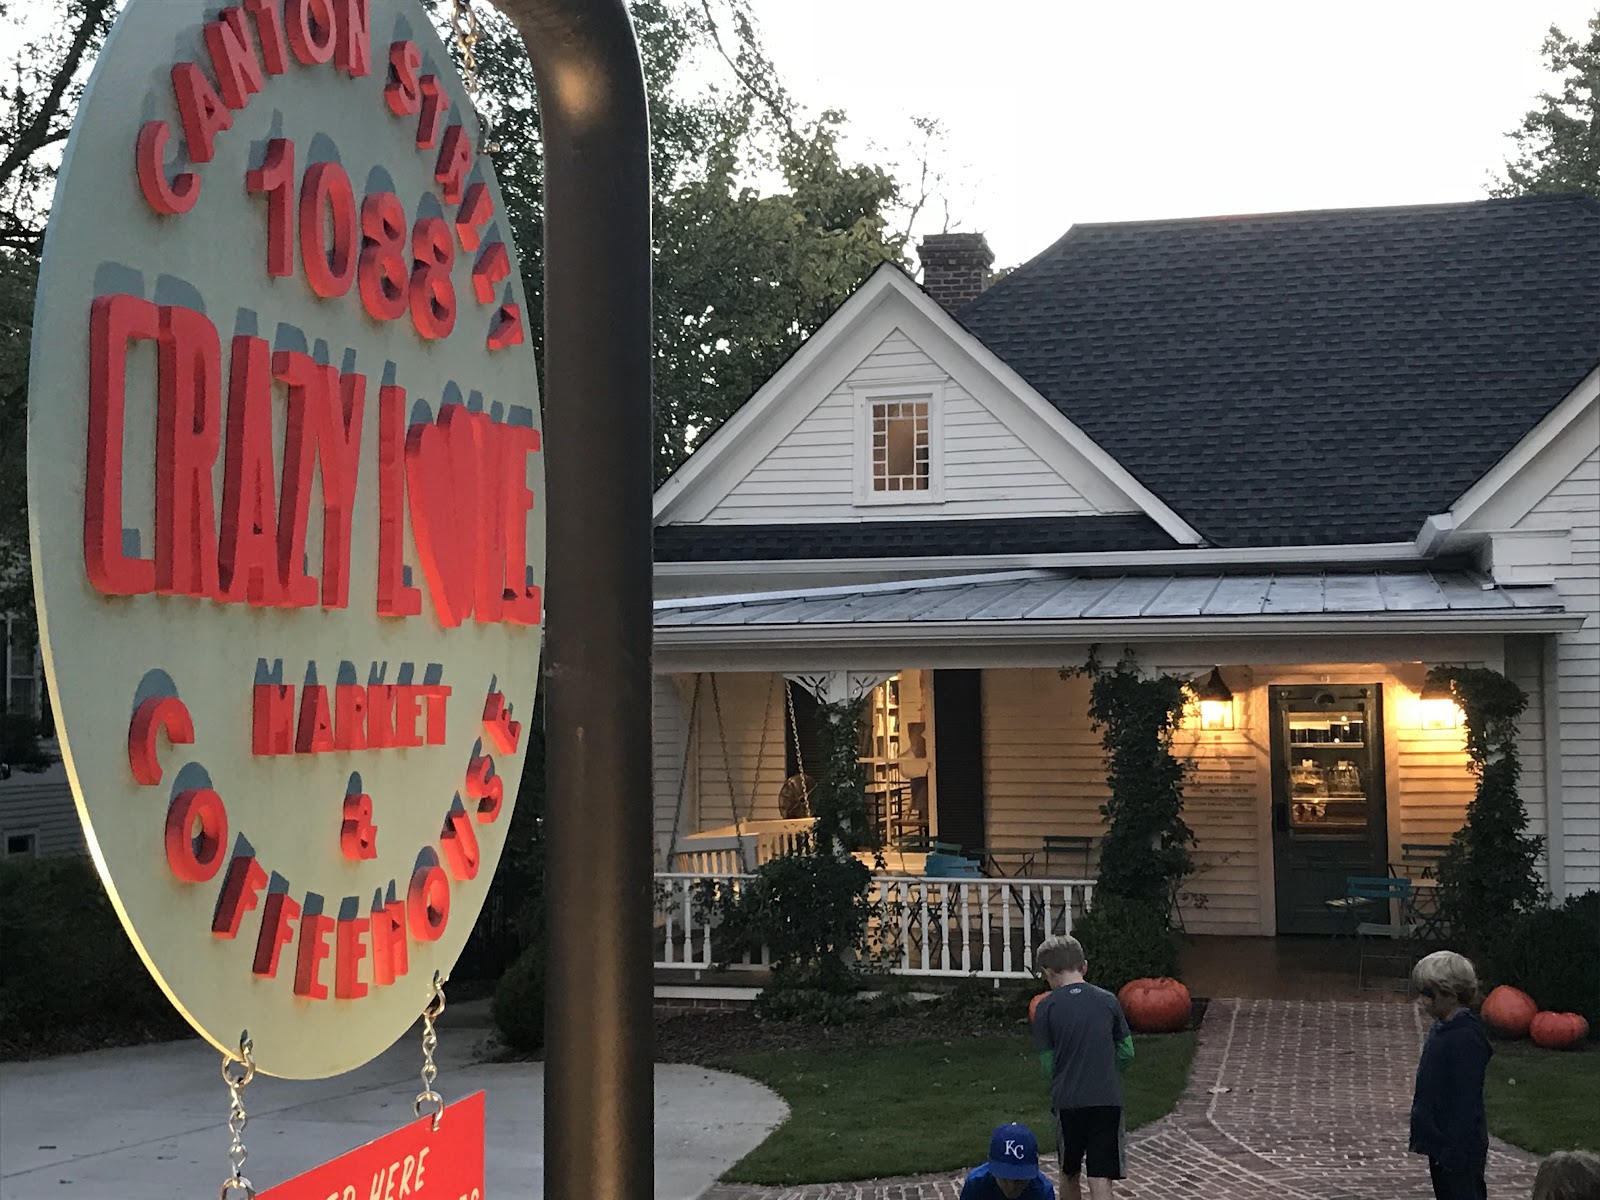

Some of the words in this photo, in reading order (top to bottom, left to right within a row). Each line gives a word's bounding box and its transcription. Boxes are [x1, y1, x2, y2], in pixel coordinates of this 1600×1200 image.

[136, 0, 371, 214] CANTON
[385, 40, 524, 350] STREET
[247, 138, 456, 340] 1088
[84, 293, 366, 610] CRAZY
[252, 684, 452, 756] MARKET
[128, 696, 521, 1000] COFFEEHOUSE
[341, 793, 377, 860] &
[369, 1146, 430, 1200] HERE
[1004, 1139, 1025, 1160] KC
